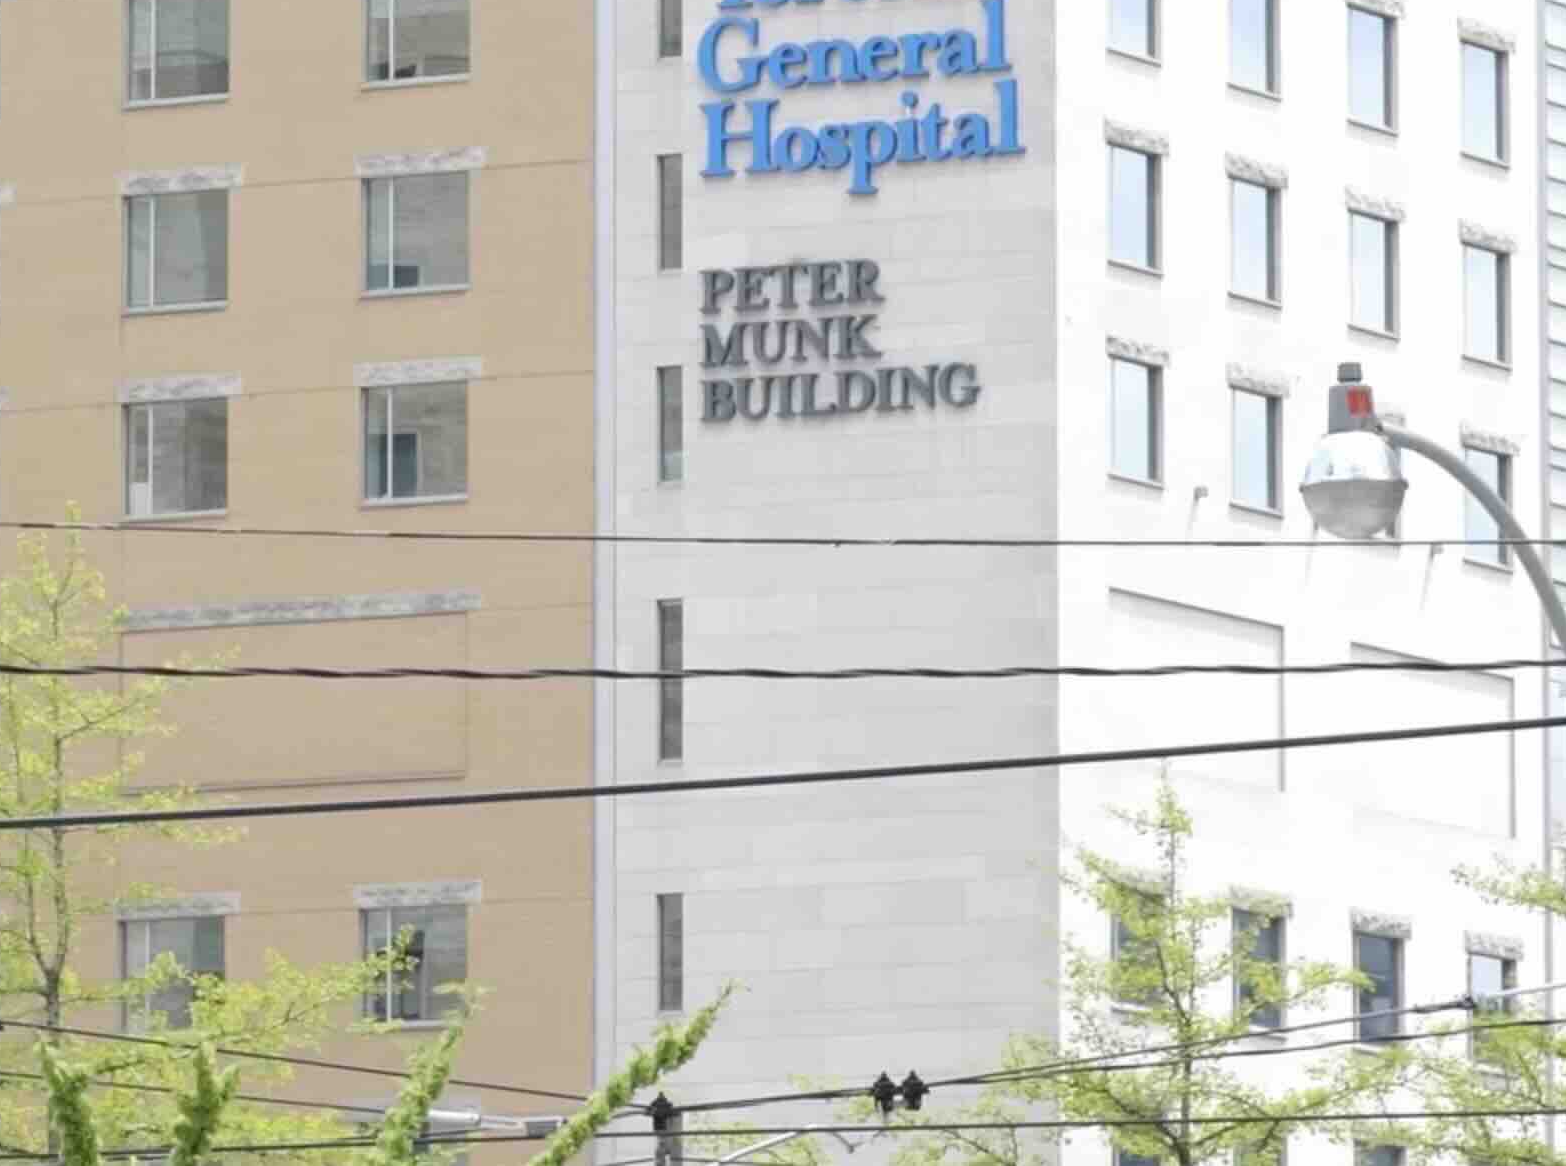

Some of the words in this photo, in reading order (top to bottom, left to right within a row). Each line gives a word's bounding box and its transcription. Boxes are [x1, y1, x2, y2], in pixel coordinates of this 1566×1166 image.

[700, 80, 1025, 195] Hospital
[699, 260, 885, 314] PETER
[700, 315, 882, 369] MUNK
[700, 364, 981, 423] BUILDING
